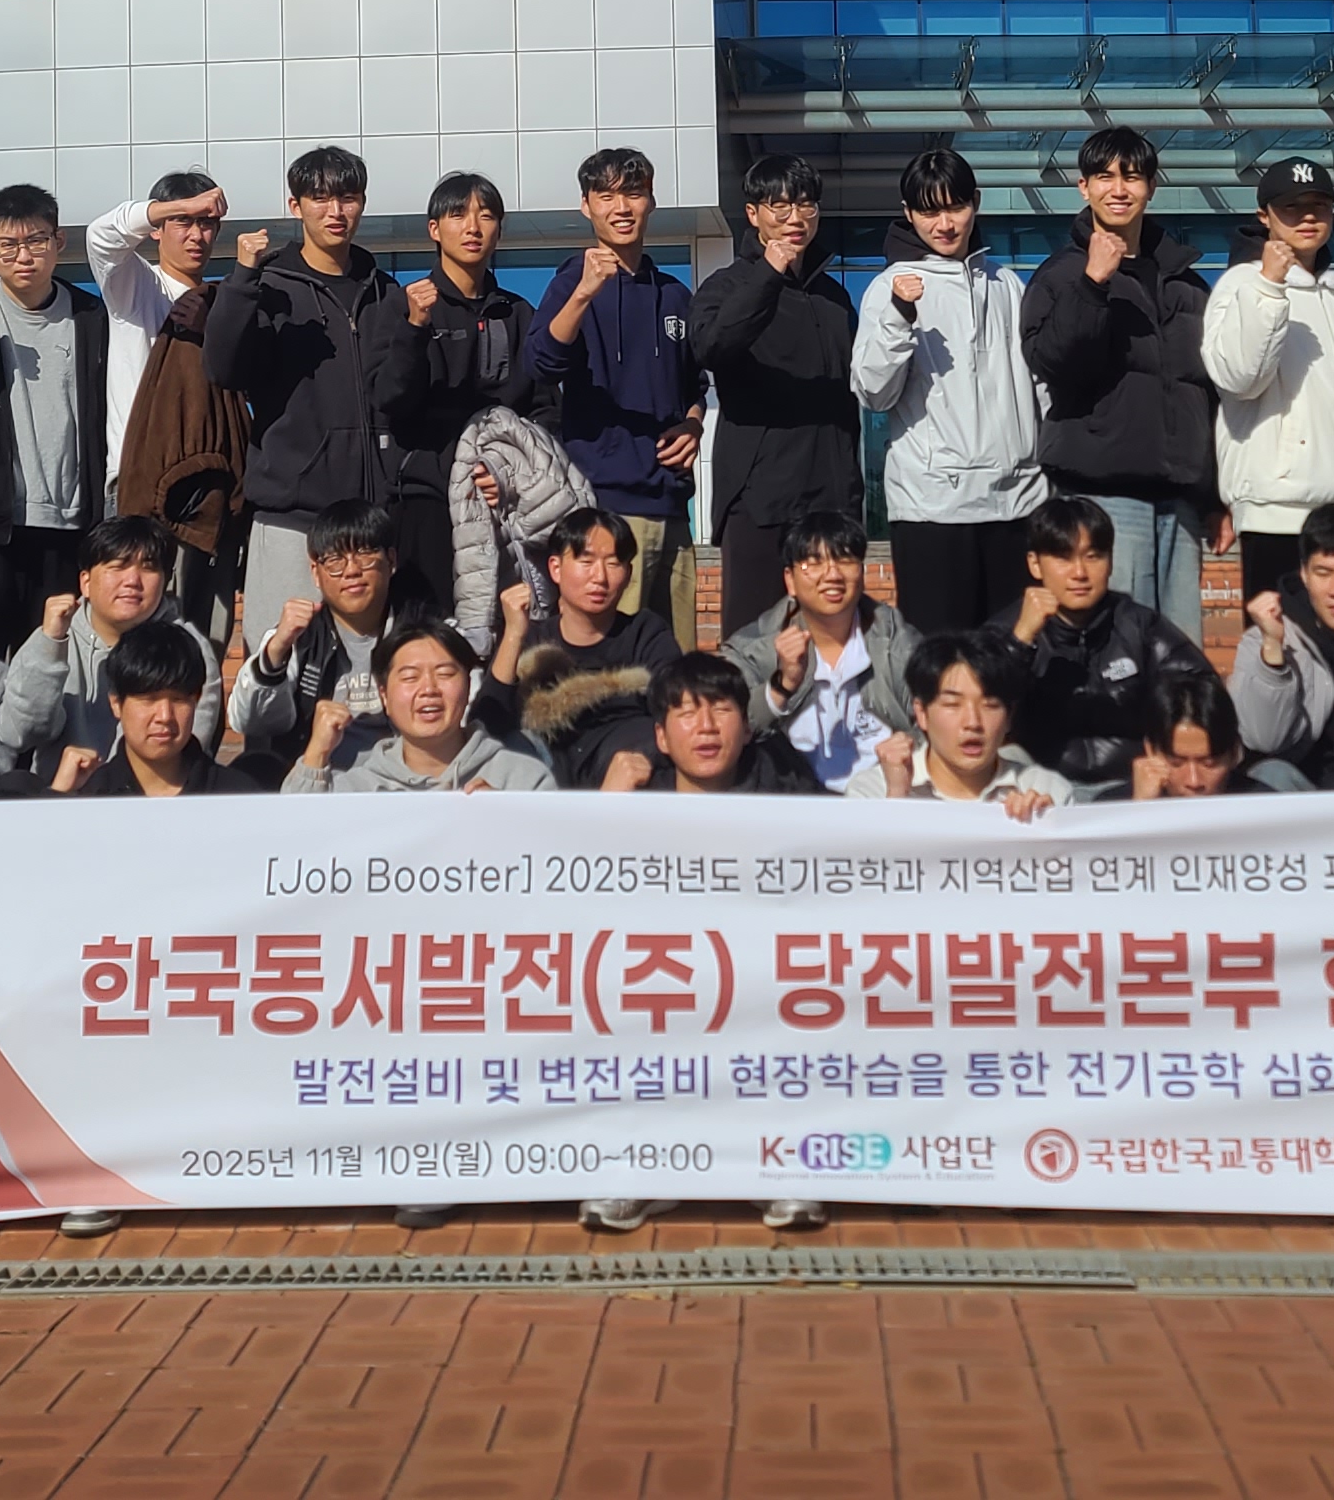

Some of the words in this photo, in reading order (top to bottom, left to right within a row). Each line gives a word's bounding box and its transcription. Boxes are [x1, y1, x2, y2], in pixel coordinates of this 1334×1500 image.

[1292, 163, 1314, 183] NY
[266, 856, 352, 896] [Job
[367, 854, 531, 894] Booster]
[545, 854, 741, 893] 2025학년도
[754, 855, 925, 894] 전기공학과
[939, 856, 1074, 893] 지역산업
[1088, 855, 1155, 893] 연계
[1170, 853, 1308, 892] 인재양성
[81, 929, 736, 1037] 한국동서발전(주)
[772, 930, 1281, 1030] 당진발전본부
[292, 1057, 463, 1106] 발전설비
[481, 1056, 522, 1105] 및
[538, 1055, 710, 1104] 변전설비
[729, 1052, 948, 1099] 현장학습을
[963, 1051, 1050, 1098] 통한
[1066, 1051, 1245, 1099] 전기공학
[181, 1146, 295, 1178] 2025년
[306, 1144, 364, 1178] 11월
[373, 1140, 492, 1179] 10일(월)
[505, 1141, 714, 1175] 09:00~18:00
[760, 1134, 892, 1169] K-RISE
[901, 1135, 997, 1170] 사업단
